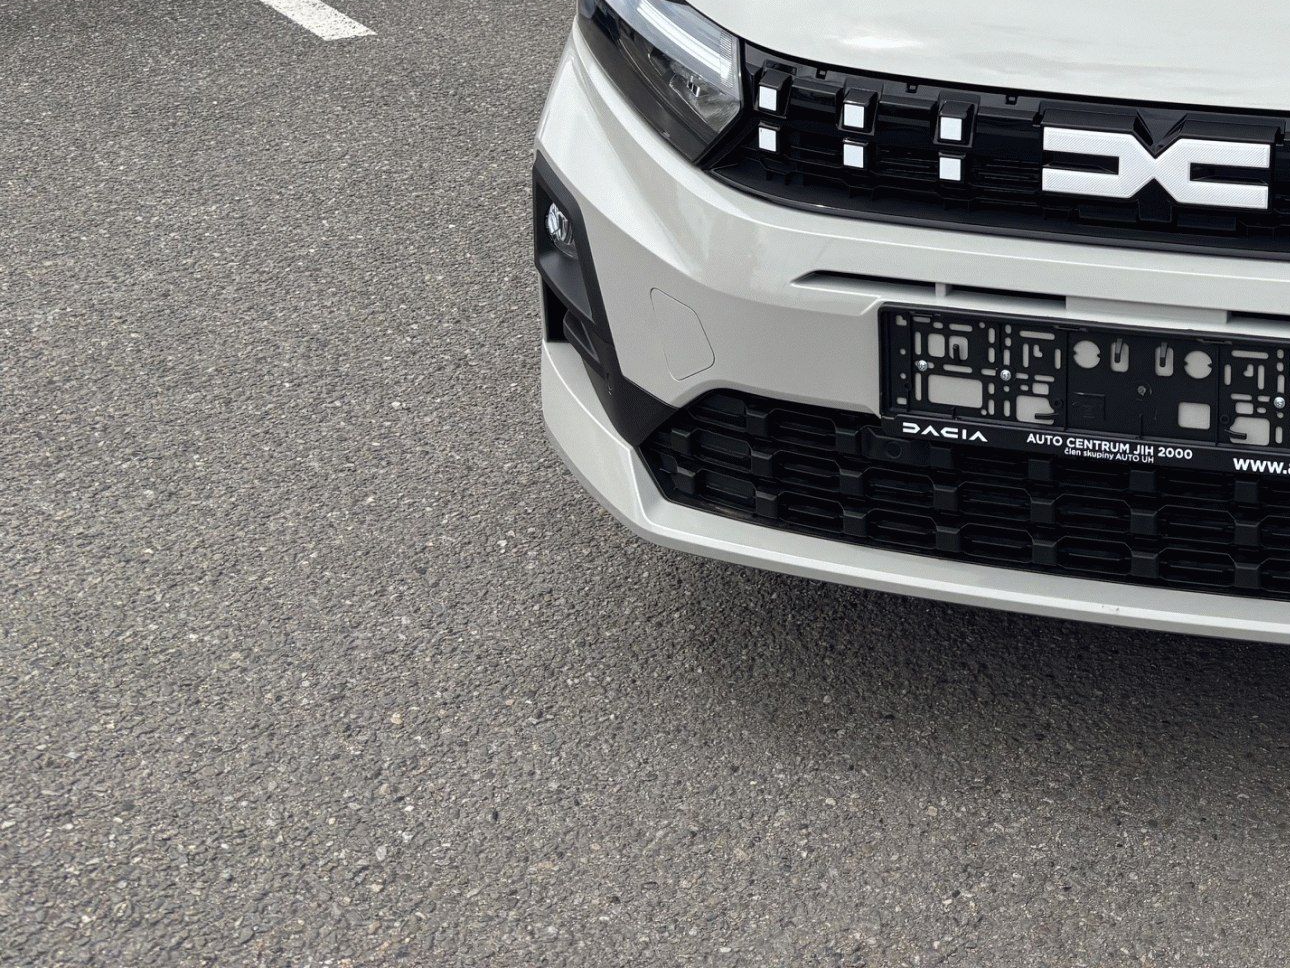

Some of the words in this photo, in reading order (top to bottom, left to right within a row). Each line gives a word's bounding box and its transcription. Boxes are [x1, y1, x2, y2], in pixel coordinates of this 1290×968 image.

[902, 421, 988, 443] DACIA
[1026, 433, 1063, 447] AUTO
[1066, 437, 1130, 454] CENTRUM
[1133, 444, 1154, 456] JIH
[1157, 446, 1193, 460] 2000
[1064, 447, 1081, 456] člen
[1083, 449, 1114, 460] skupiny
[1115, 453, 1139, 463] AUTO
[1141, 455, 1154, 464] UH
